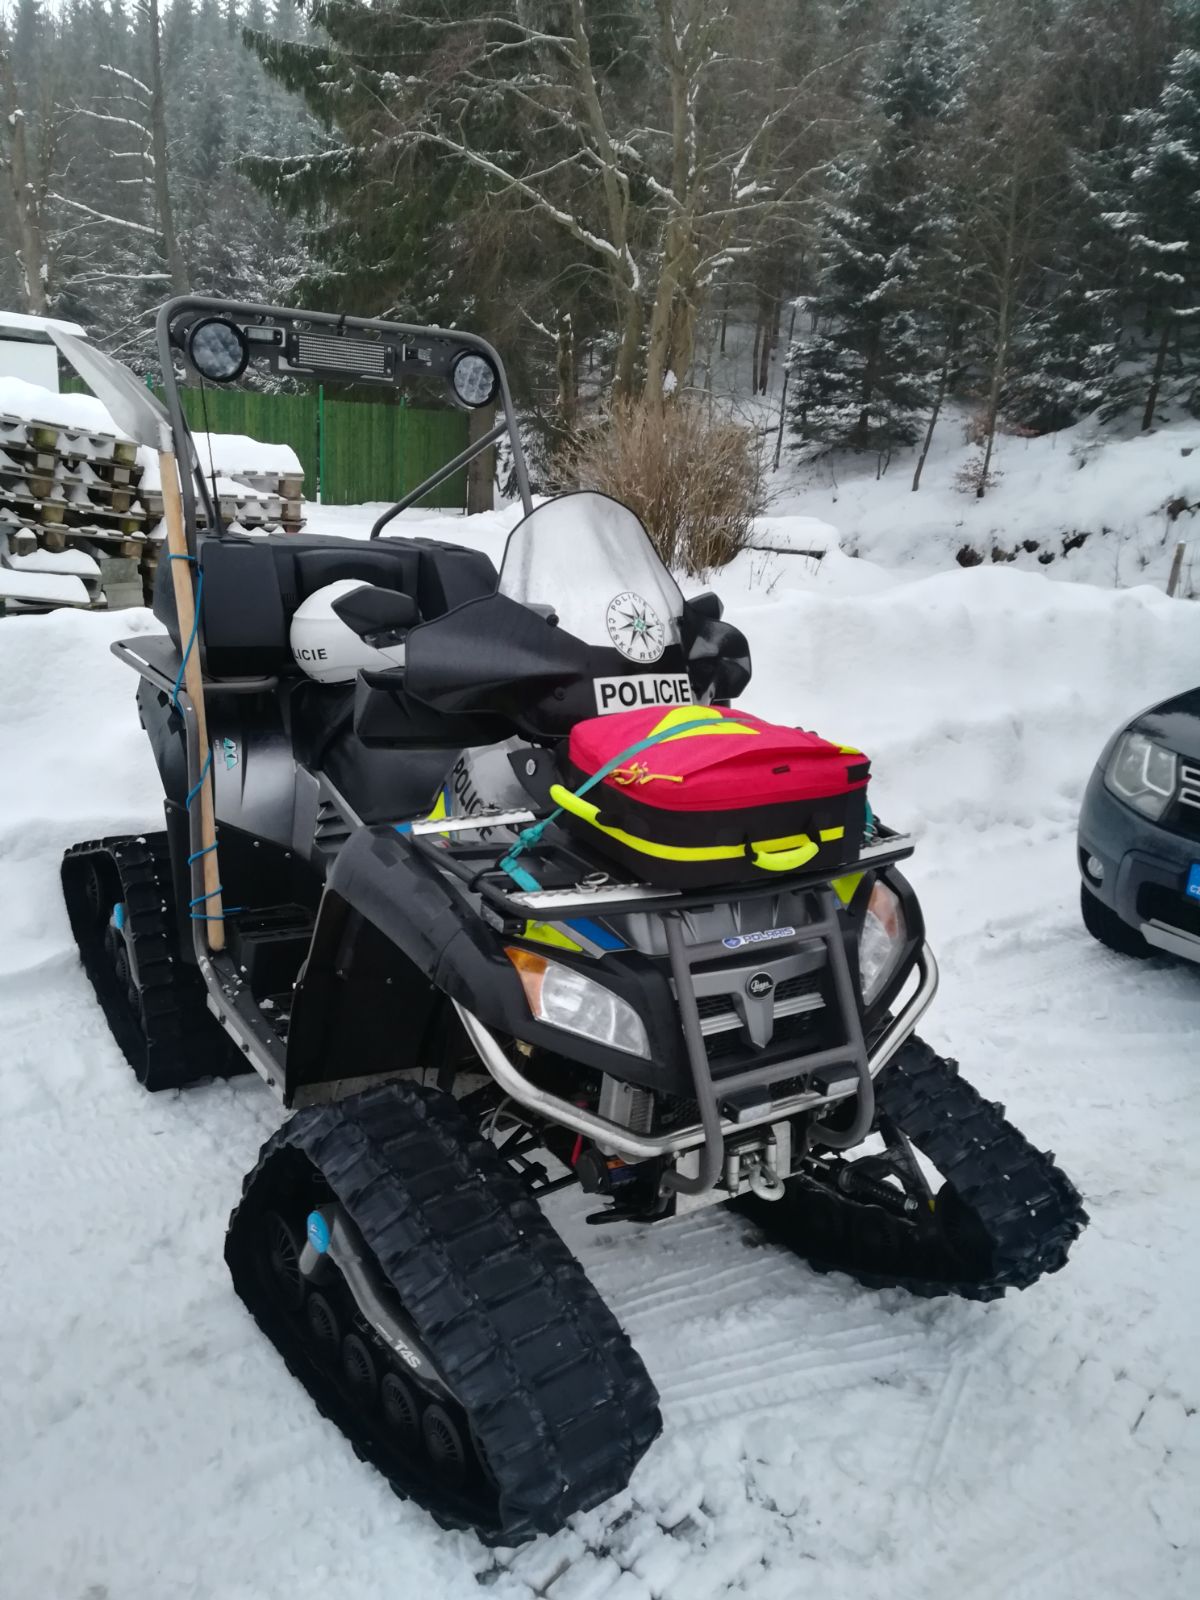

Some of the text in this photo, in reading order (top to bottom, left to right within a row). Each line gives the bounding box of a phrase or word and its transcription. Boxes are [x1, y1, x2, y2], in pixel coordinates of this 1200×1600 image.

[600, 679, 692, 708] POLICIE
[742, 927, 794, 943] POLARIS
[394, 1339, 422, 1369] T4S
